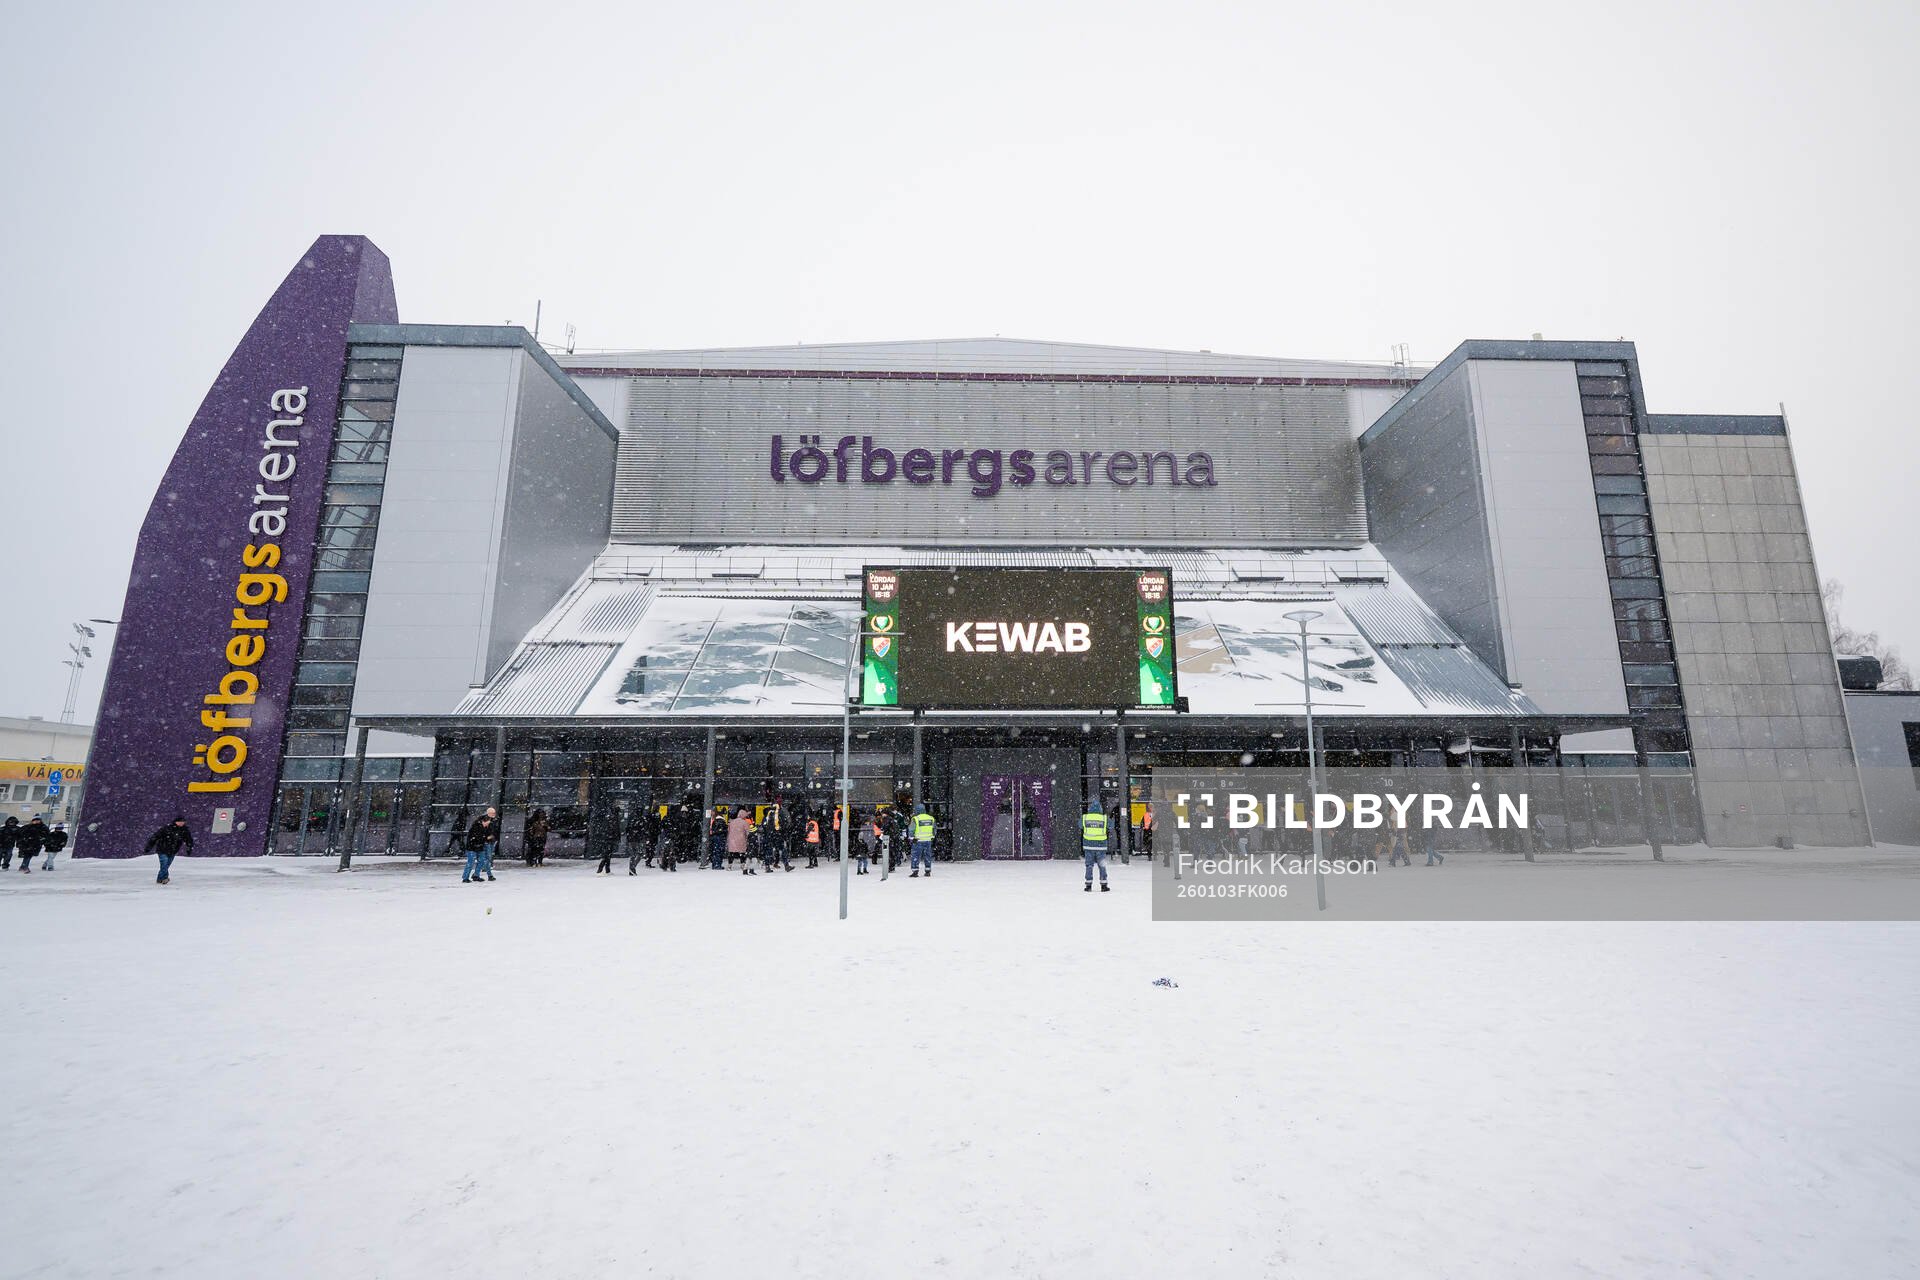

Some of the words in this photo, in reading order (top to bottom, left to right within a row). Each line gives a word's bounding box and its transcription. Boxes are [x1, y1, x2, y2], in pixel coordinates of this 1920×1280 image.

[771, 434, 1219, 497] löfbergsarena
[188, 385, 309, 793] löfbergsarena
[946, 622, 1091, 652] KEWAB
[619, 782, 624, 790] 1
[687, 782, 693, 790] 2
[778, 781, 784, 790] 3
[808, 781, 814, 790] 4
[897, 781, 903, 789] 5
[1103, 780, 1110, 788] 6
[1192, 779, 1198, 788] 7
[1220, 779, 1226, 788] 8
[1384, 778, 1394, 787] 10
